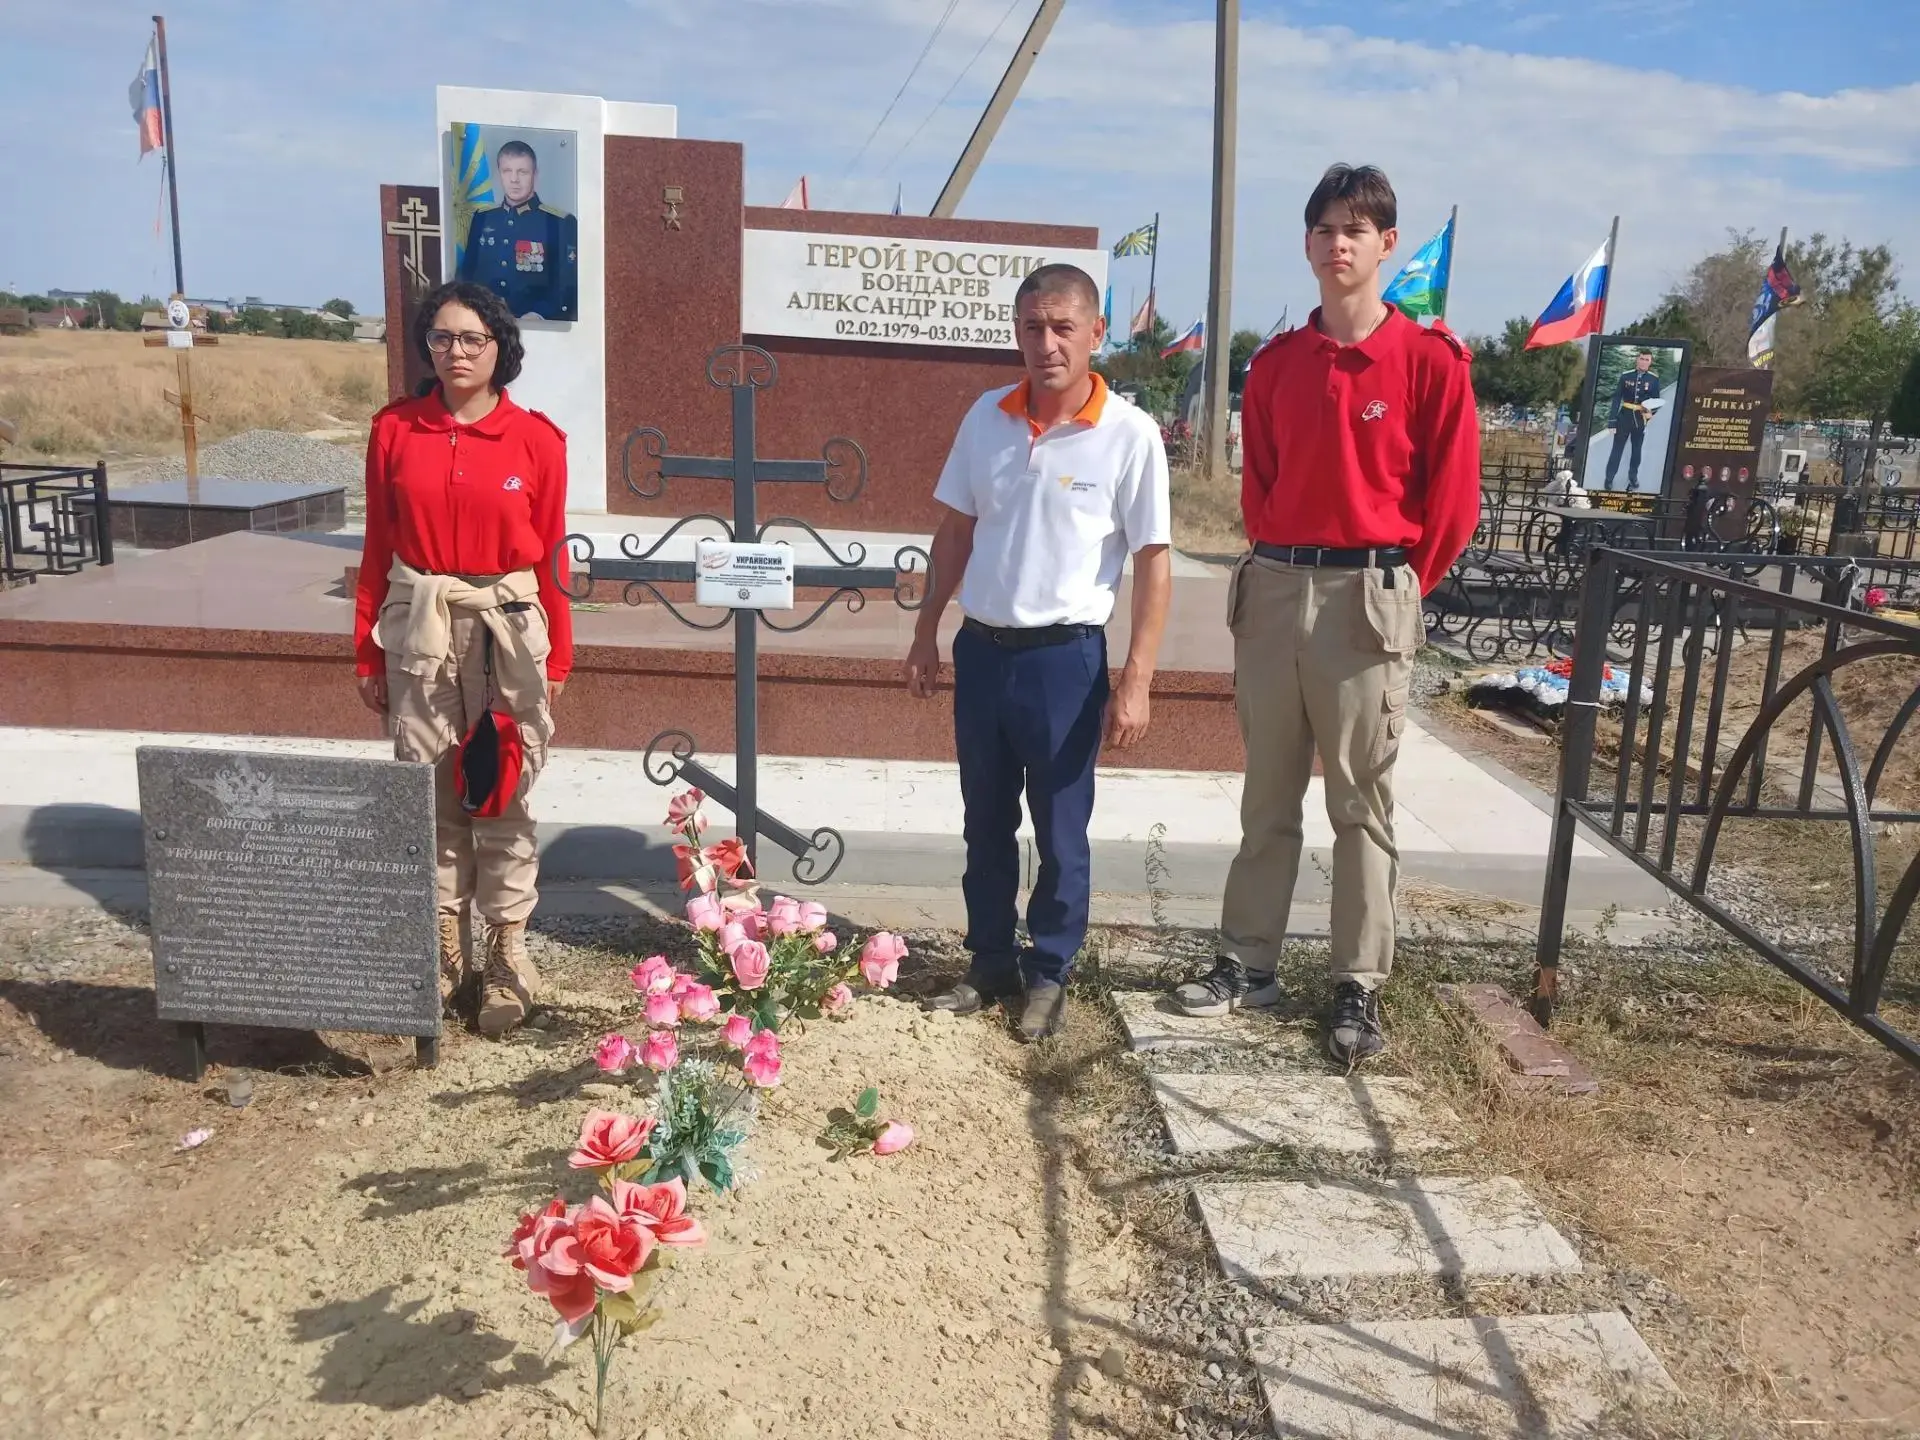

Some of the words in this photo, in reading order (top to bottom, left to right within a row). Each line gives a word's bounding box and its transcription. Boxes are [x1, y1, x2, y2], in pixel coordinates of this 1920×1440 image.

[806, 243, 908, 271] ГЕРОЙ
[914, 249, 1046, 279] РОССИИ
[861, 272, 991, 298] БОНДАРЕВ
[786, 291, 937, 320] АЛЕКСАНДР
[942, 302, 1017, 323] ЮРЬЕ
[205, 816, 276, 833] ВОИНСКОЕ
[280, 821, 375, 840] ЗАХОРОНЕНИЕ
[165, 845, 254, 863] УКРАИНСКИЙ
[254, 852, 332, 869] АЛЕКСАНДР
[333, 857, 421, 875] ВАСИЛЬЕВИЧ
